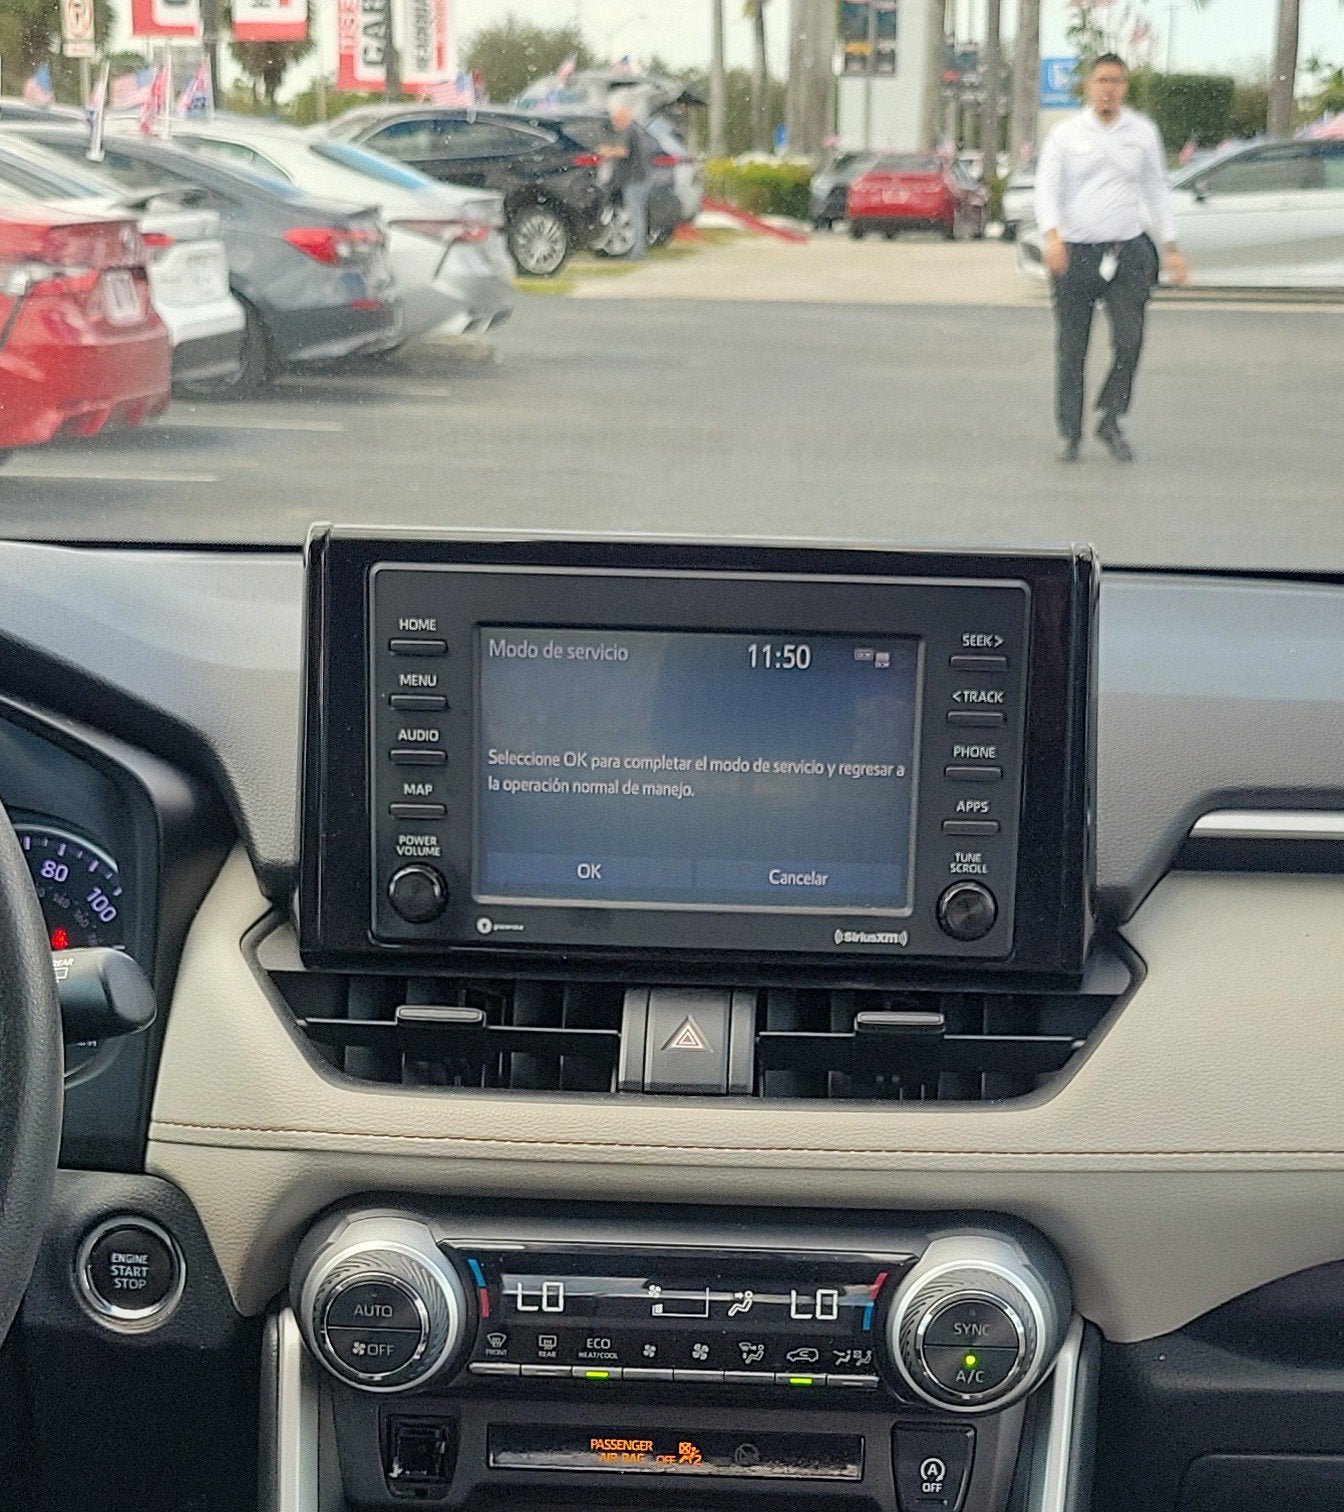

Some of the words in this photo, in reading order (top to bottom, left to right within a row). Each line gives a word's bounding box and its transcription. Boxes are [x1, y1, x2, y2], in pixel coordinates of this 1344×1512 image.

[398, 618, 437, 631] HOME
[489, 638, 538, 658] Modo
[543, 641, 563, 658] de
[567, 644, 629, 661] servicio
[748, 643, 811, 669] 11:50
[399, 674, 437, 687] MENU
[398, 729, 439, 742] AUDIO
[953, 745, 997, 758] PHONE
[488, 748, 560, 767] Seleccione
[564, 751, 588, 768] OK
[591, 758, 620, 770] para
[624, 755, 692, 773] completar
[695, 755, 707, 771] el
[710, 757, 750, 773] modo
[753, 758, 770, 773] de
[773, 760, 825, 775] servicio
[827, 764, 837, 778] y
[839, 765, 894, 779] regresar
[896, 766, 905, 777] a
[404, 784, 433, 796] MAP
[488, 775, 500, 791] la
[503, 778, 569, 794] operación
[573, 780, 618, 795] normal
[622, 779, 640, 795] de
[643, 781, 695, 799] manejo.
[956, 801, 989, 813] APPS
[399, 835, 437, 846] POWER
[396, 845, 441, 856] VOLUME
[955, 852, 981, 863] TUNE
[41, 859, 69, 882] 80
[577, 863, 601, 879] OK
[950, 863, 987, 874] SCROLL
[769, 869, 829, 886] Cancelar
[87, 887, 116, 923] 100
[111, 1252, 149, 1264] ENGINE
[110, 1264, 149, 1277] START
[114, 1278, 147, 1289] STOP
[354, 1304, 393, 1318] AUTO
[954, 1322, 991, 1336] SYNC
[367, 1343, 395, 1356] OFF
[586, 1338, 611, 1350] ECO
[578, 1352, 619, 1360] HEAT/COOL
[955, 1370, 984, 1384] A/C
[590, 1439, 654, 1451] PASSENGER
[599, 1452, 618, 1463] AIR
[622, 1453, 645, 1463] BAG
[656, 1455, 677, 1464] OFF
[922, 1482, 943, 1493] OFF
